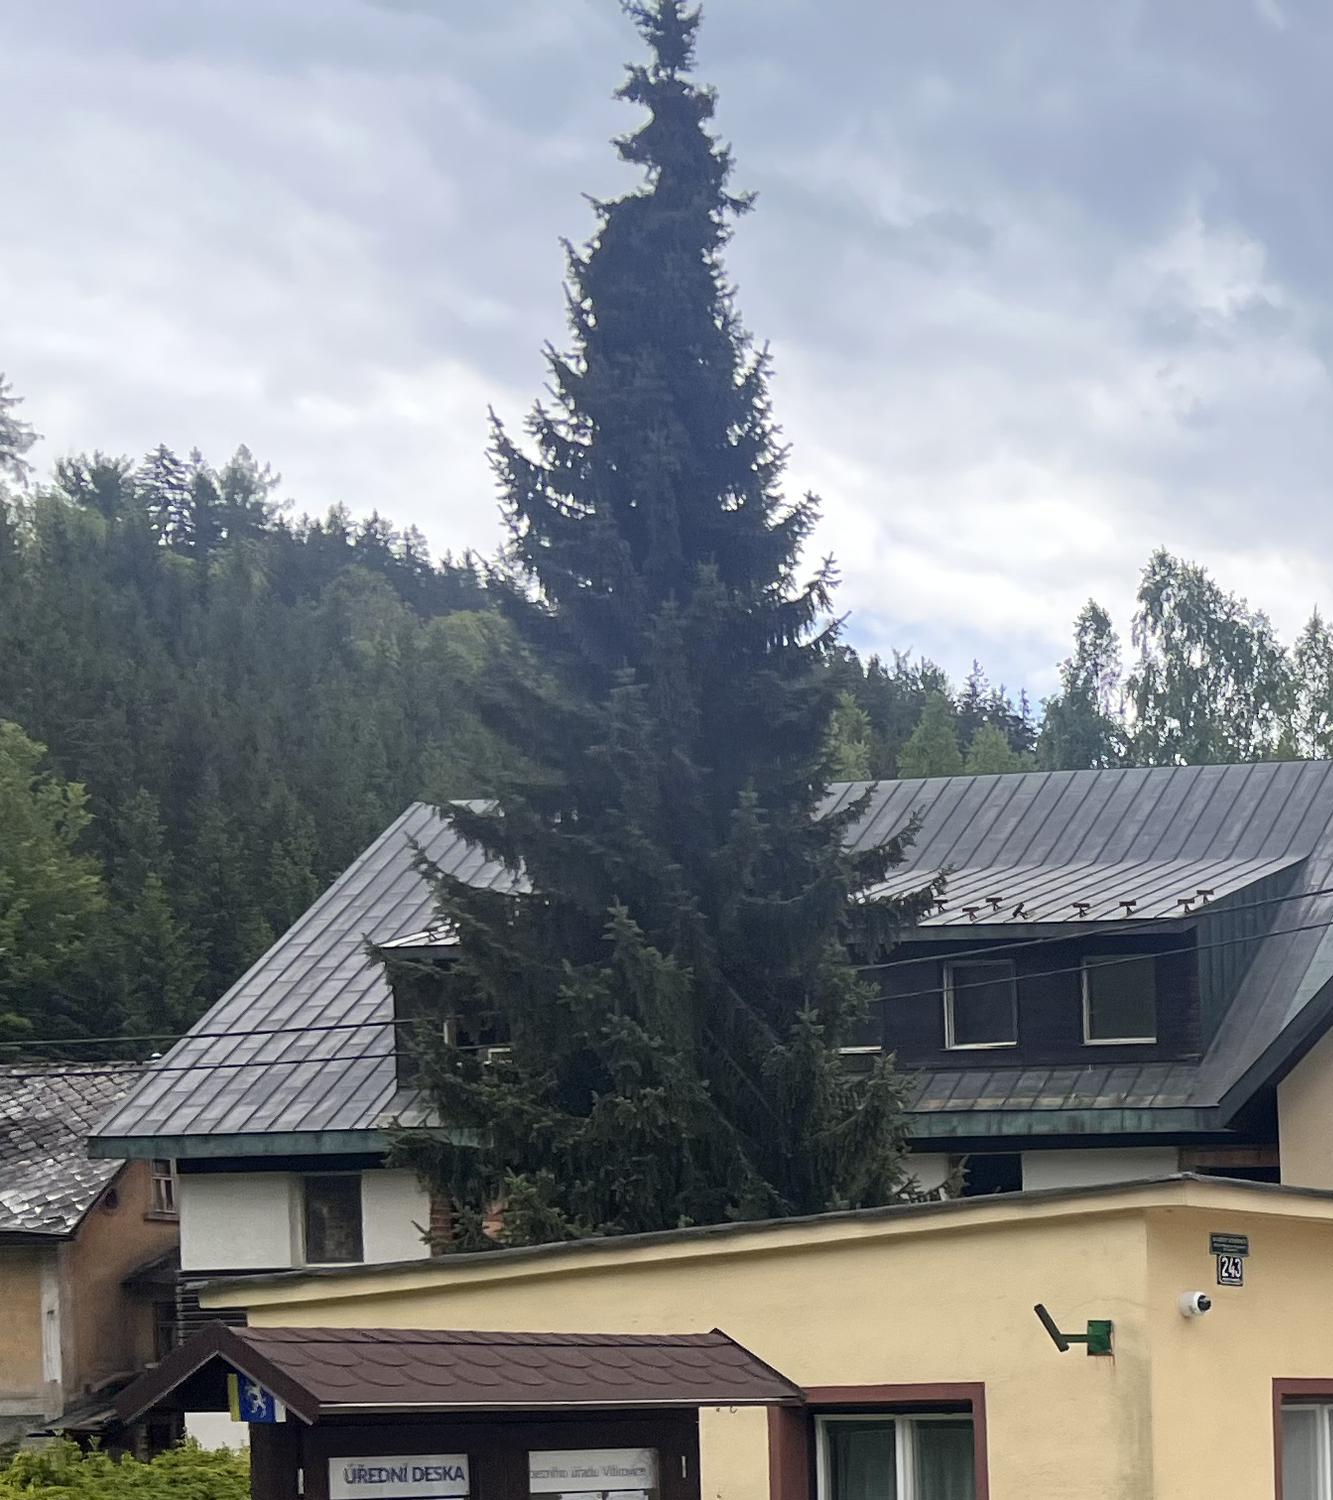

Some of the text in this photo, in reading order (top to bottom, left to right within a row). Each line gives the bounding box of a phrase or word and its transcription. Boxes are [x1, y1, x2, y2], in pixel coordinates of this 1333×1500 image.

[1221, 1257, 1242, 1278] 243
[344, 1463, 465, 1484] ÚŘEDNÍ DESKA
